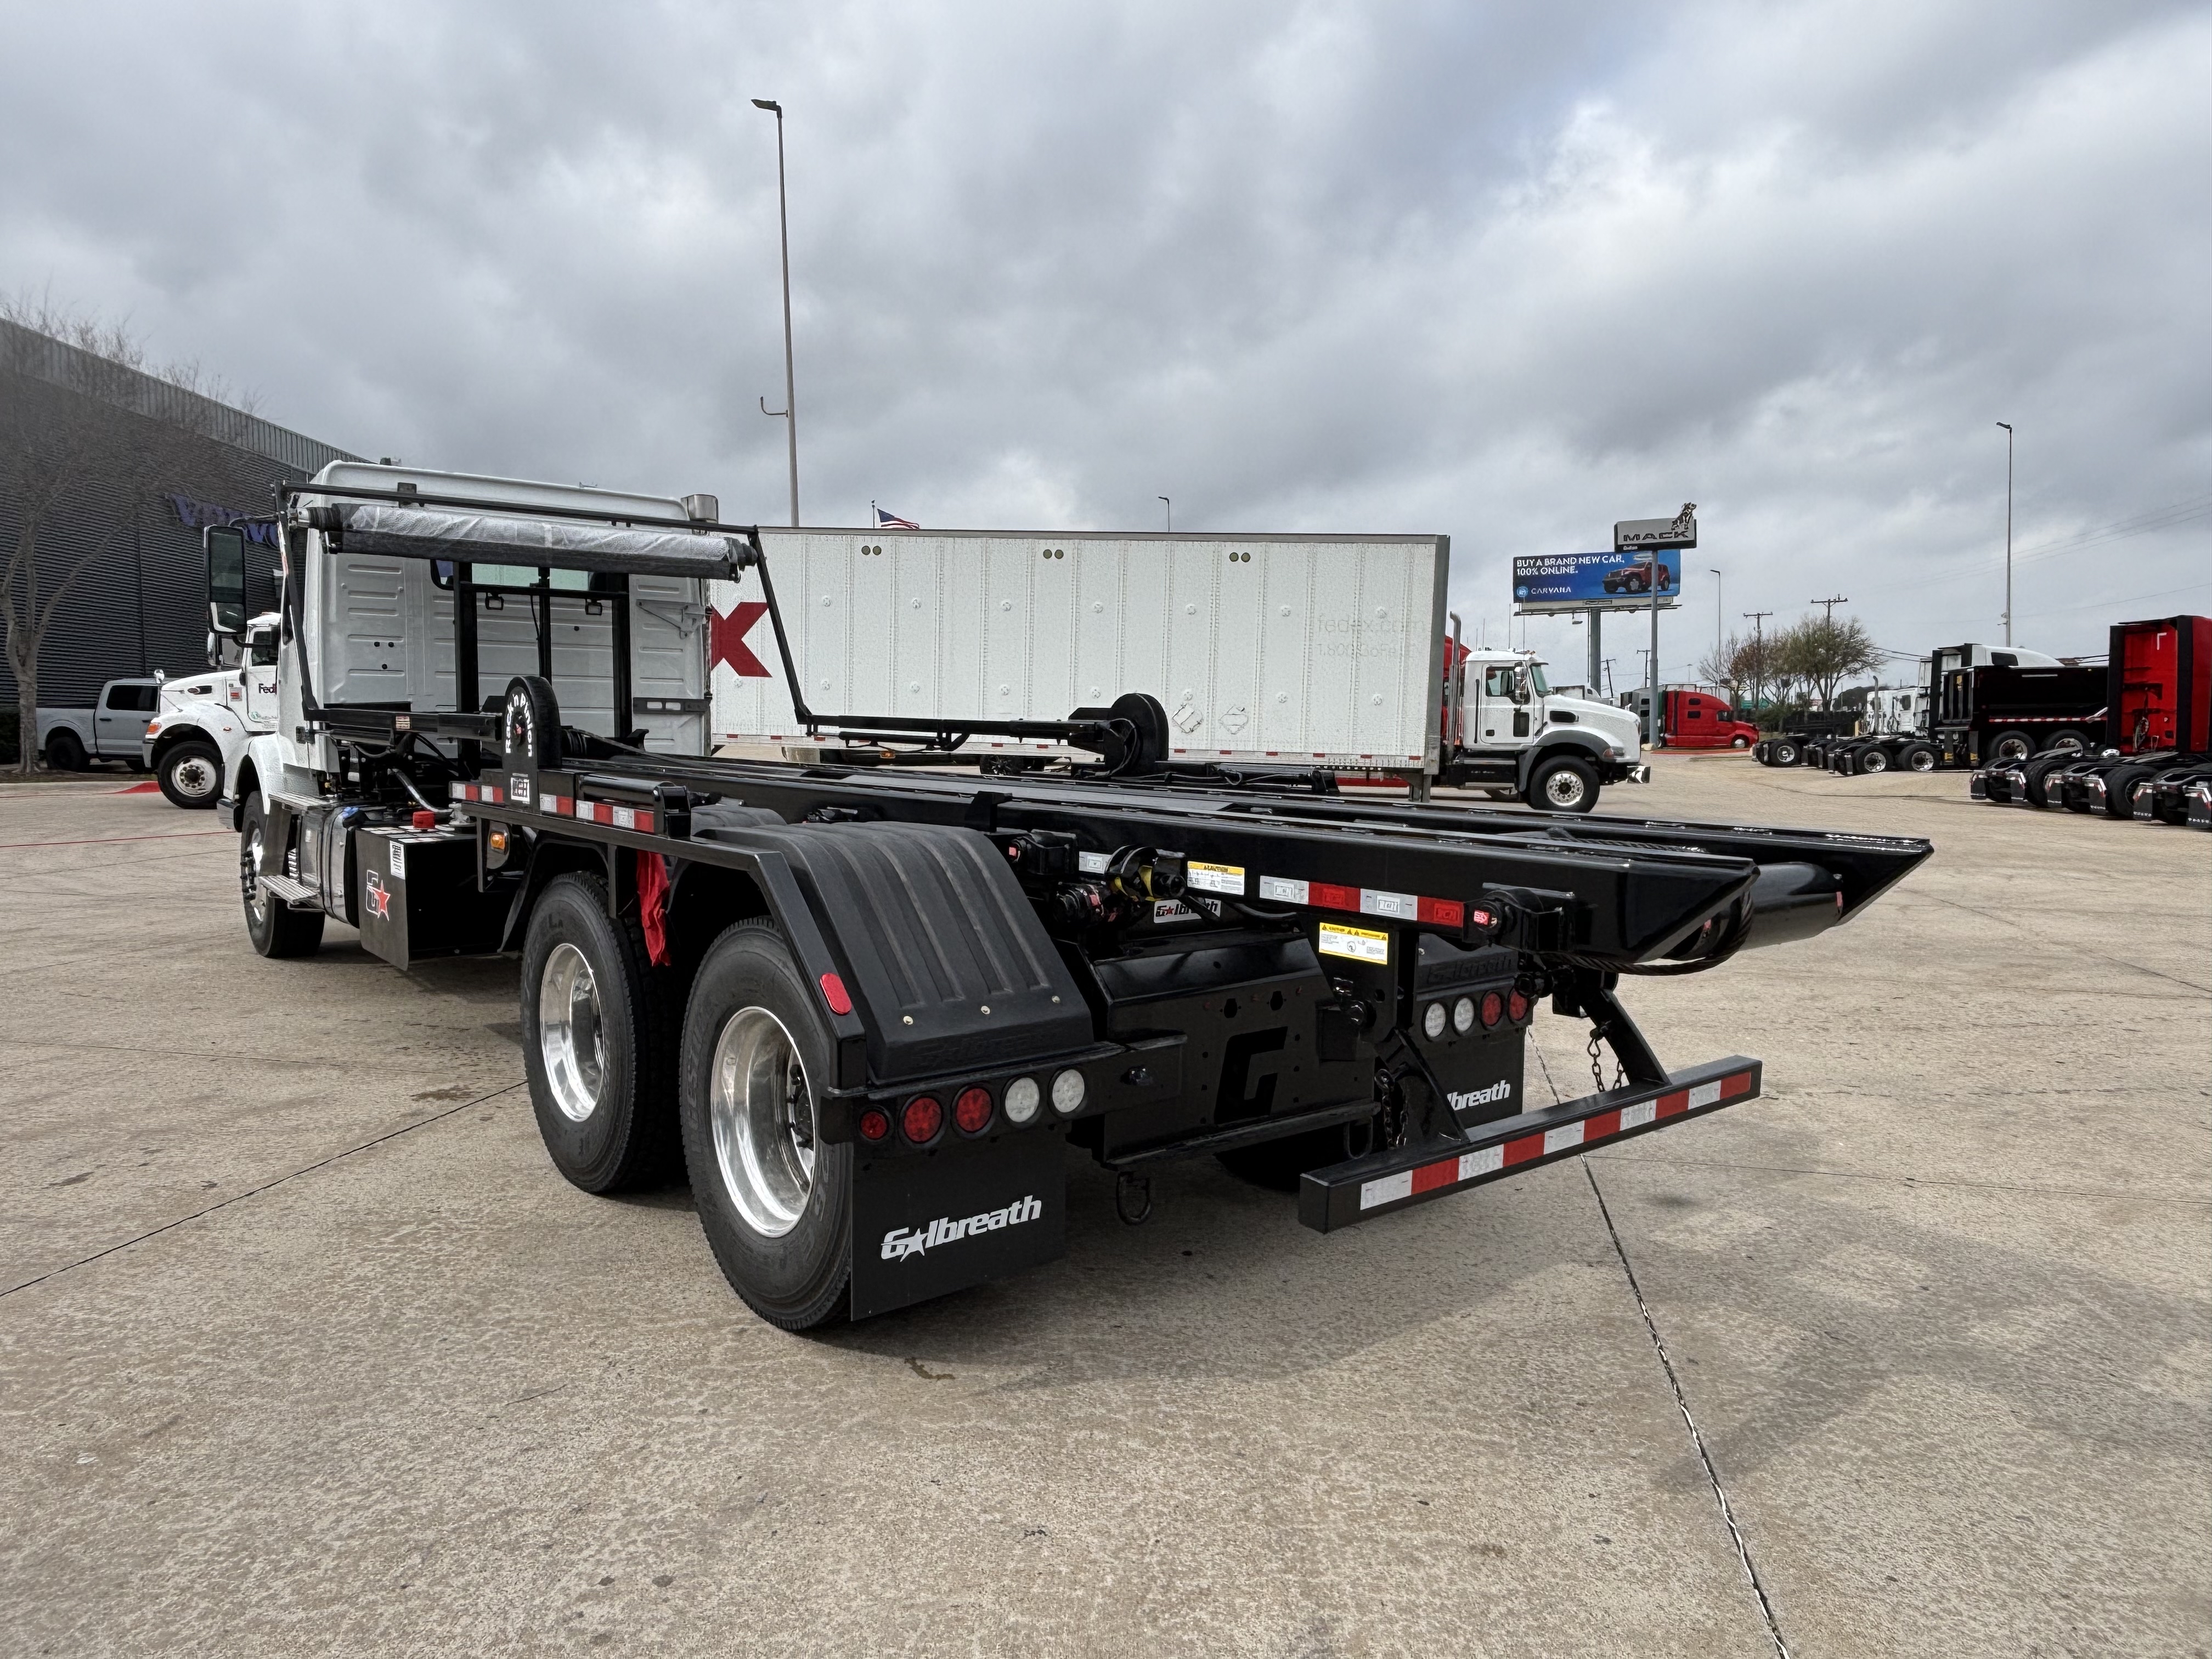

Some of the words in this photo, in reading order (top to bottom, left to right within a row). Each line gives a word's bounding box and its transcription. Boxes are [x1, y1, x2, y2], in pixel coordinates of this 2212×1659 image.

[1623, 530, 1689, 542] MACK
[1516, 558, 1536, 567] BUY
[1536, 558, 1543, 567] A
[1544, 557, 1577, 566] BRAND
[1578, 555, 1601, 565] NEW
[1516, 567, 1539, 576] 100%
[1531, 586, 1572, 595] CARVANA
